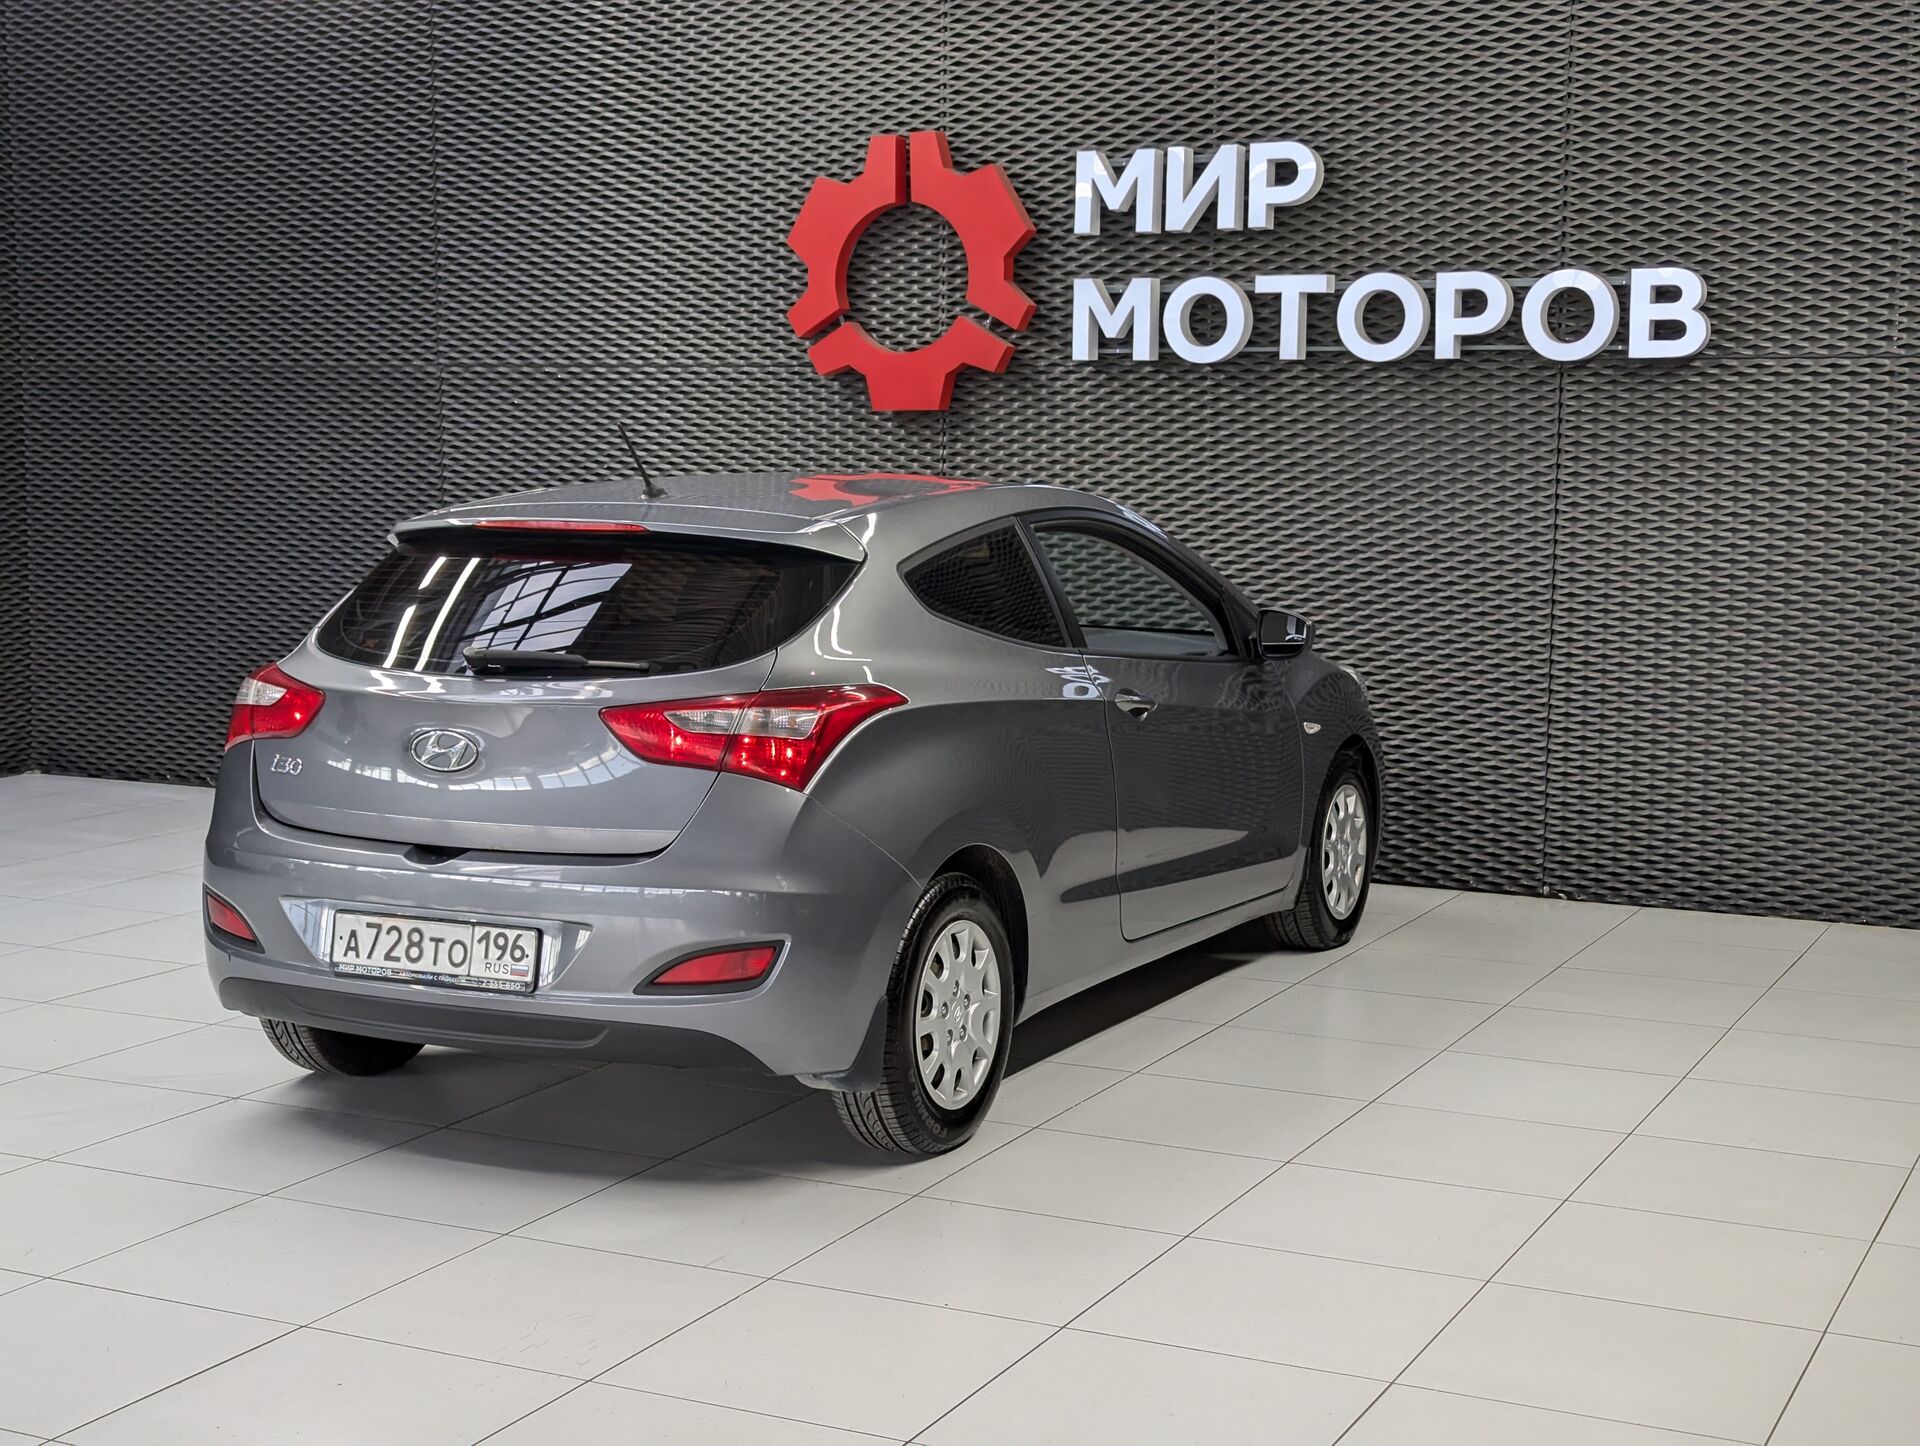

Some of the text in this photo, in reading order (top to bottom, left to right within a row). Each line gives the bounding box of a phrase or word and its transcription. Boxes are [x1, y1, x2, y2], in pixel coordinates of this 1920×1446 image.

[1074, 141, 1324, 236] МИР
[1072, 267, 1711, 364] МОТОРОВ
[343, 921, 468, 969] А728ТО
[476, 930, 526, 963] 196
[339, 963, 355, 973] МИР
[357, 966, 392, 977] МОТОРОВ
[484, 962, 509, 975] RUS
